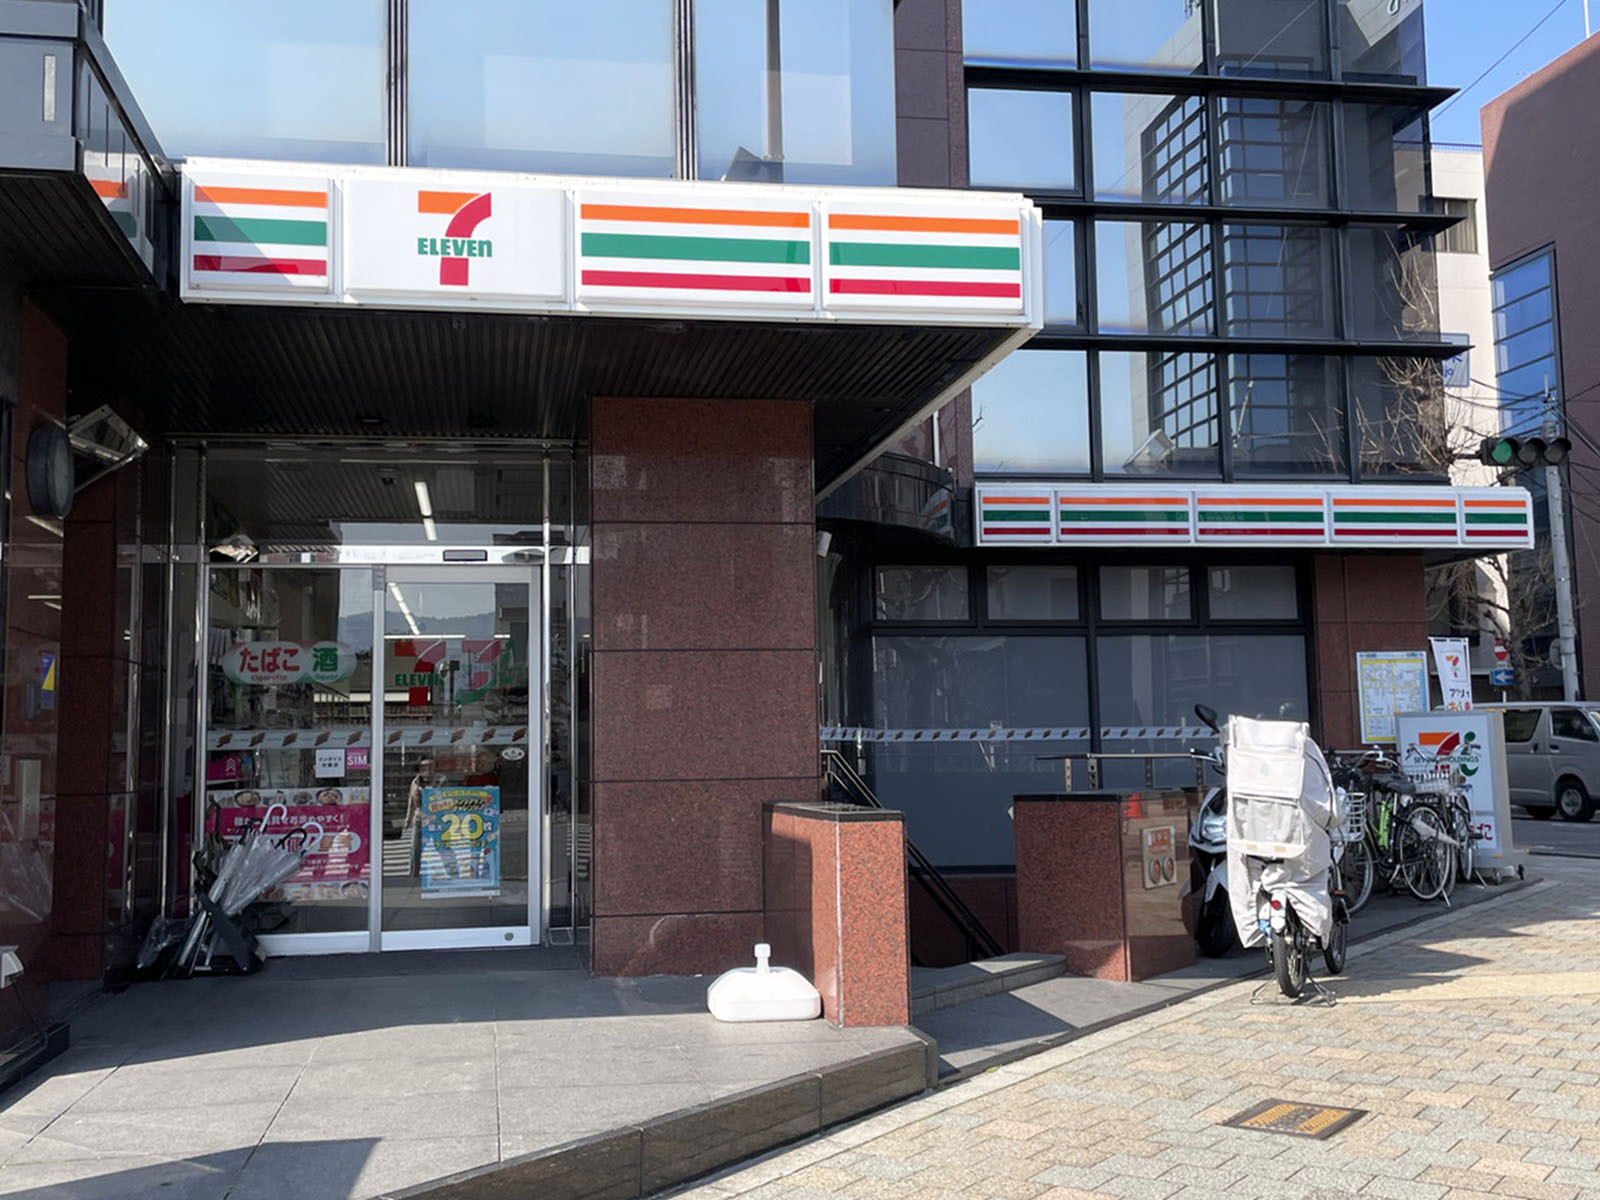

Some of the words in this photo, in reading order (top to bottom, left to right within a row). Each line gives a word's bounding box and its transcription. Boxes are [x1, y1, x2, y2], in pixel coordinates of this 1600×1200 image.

[239, 647, 300, 673] たばこ
[312, 647, 339, 672] 酒
[347, 755, 368, 766] SIM
[441, 813, 484, 841] 20
